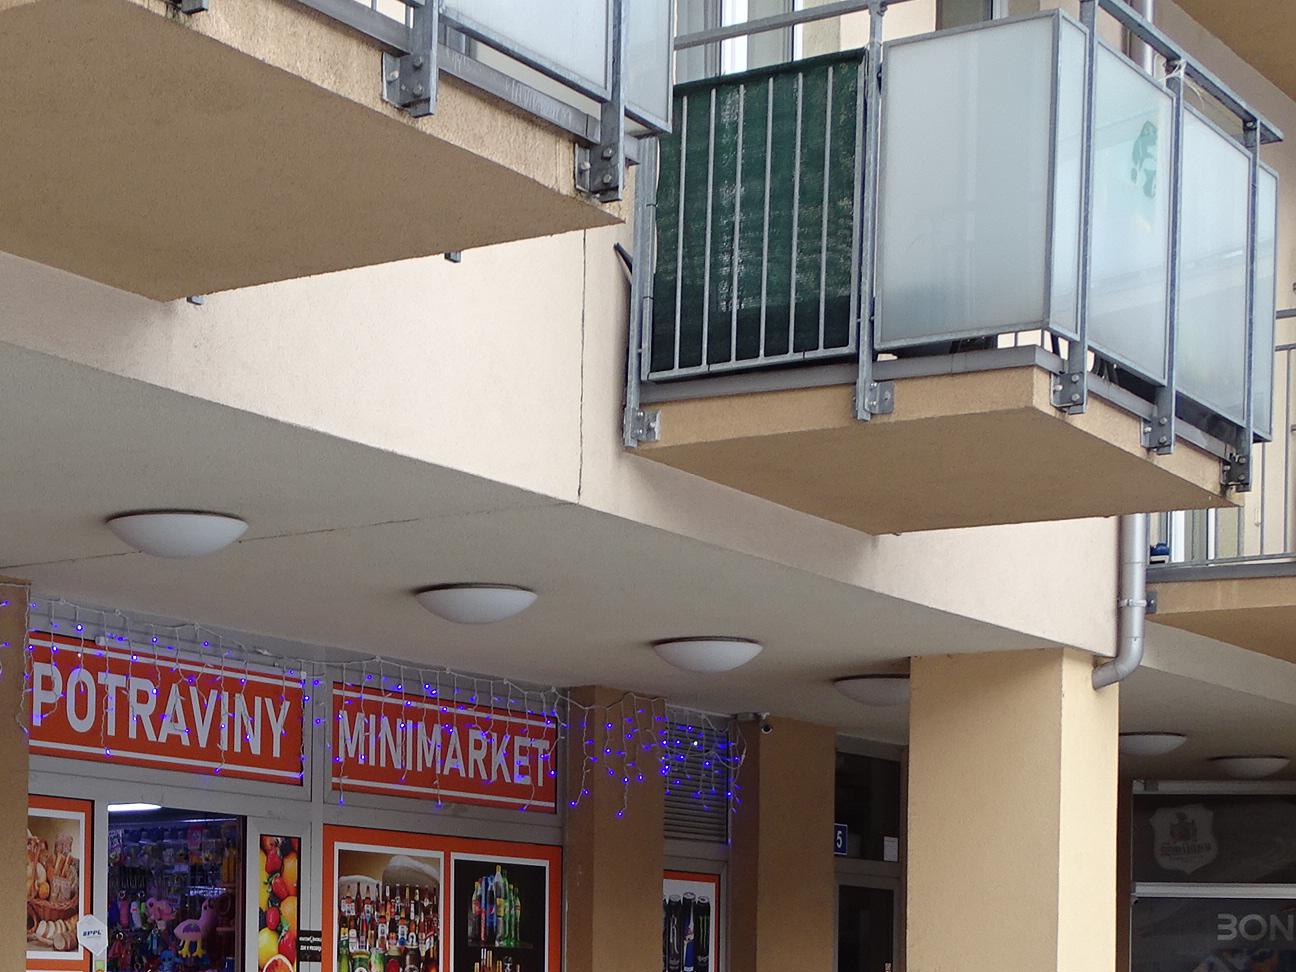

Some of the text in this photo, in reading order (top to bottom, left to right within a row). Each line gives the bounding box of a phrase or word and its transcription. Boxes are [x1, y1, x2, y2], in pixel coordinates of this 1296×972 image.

[32, 661, 291, 758] POTRAVINY
[338, 709, 550, 787] MINIMARKET
[836, 830, 843, 849] 5
